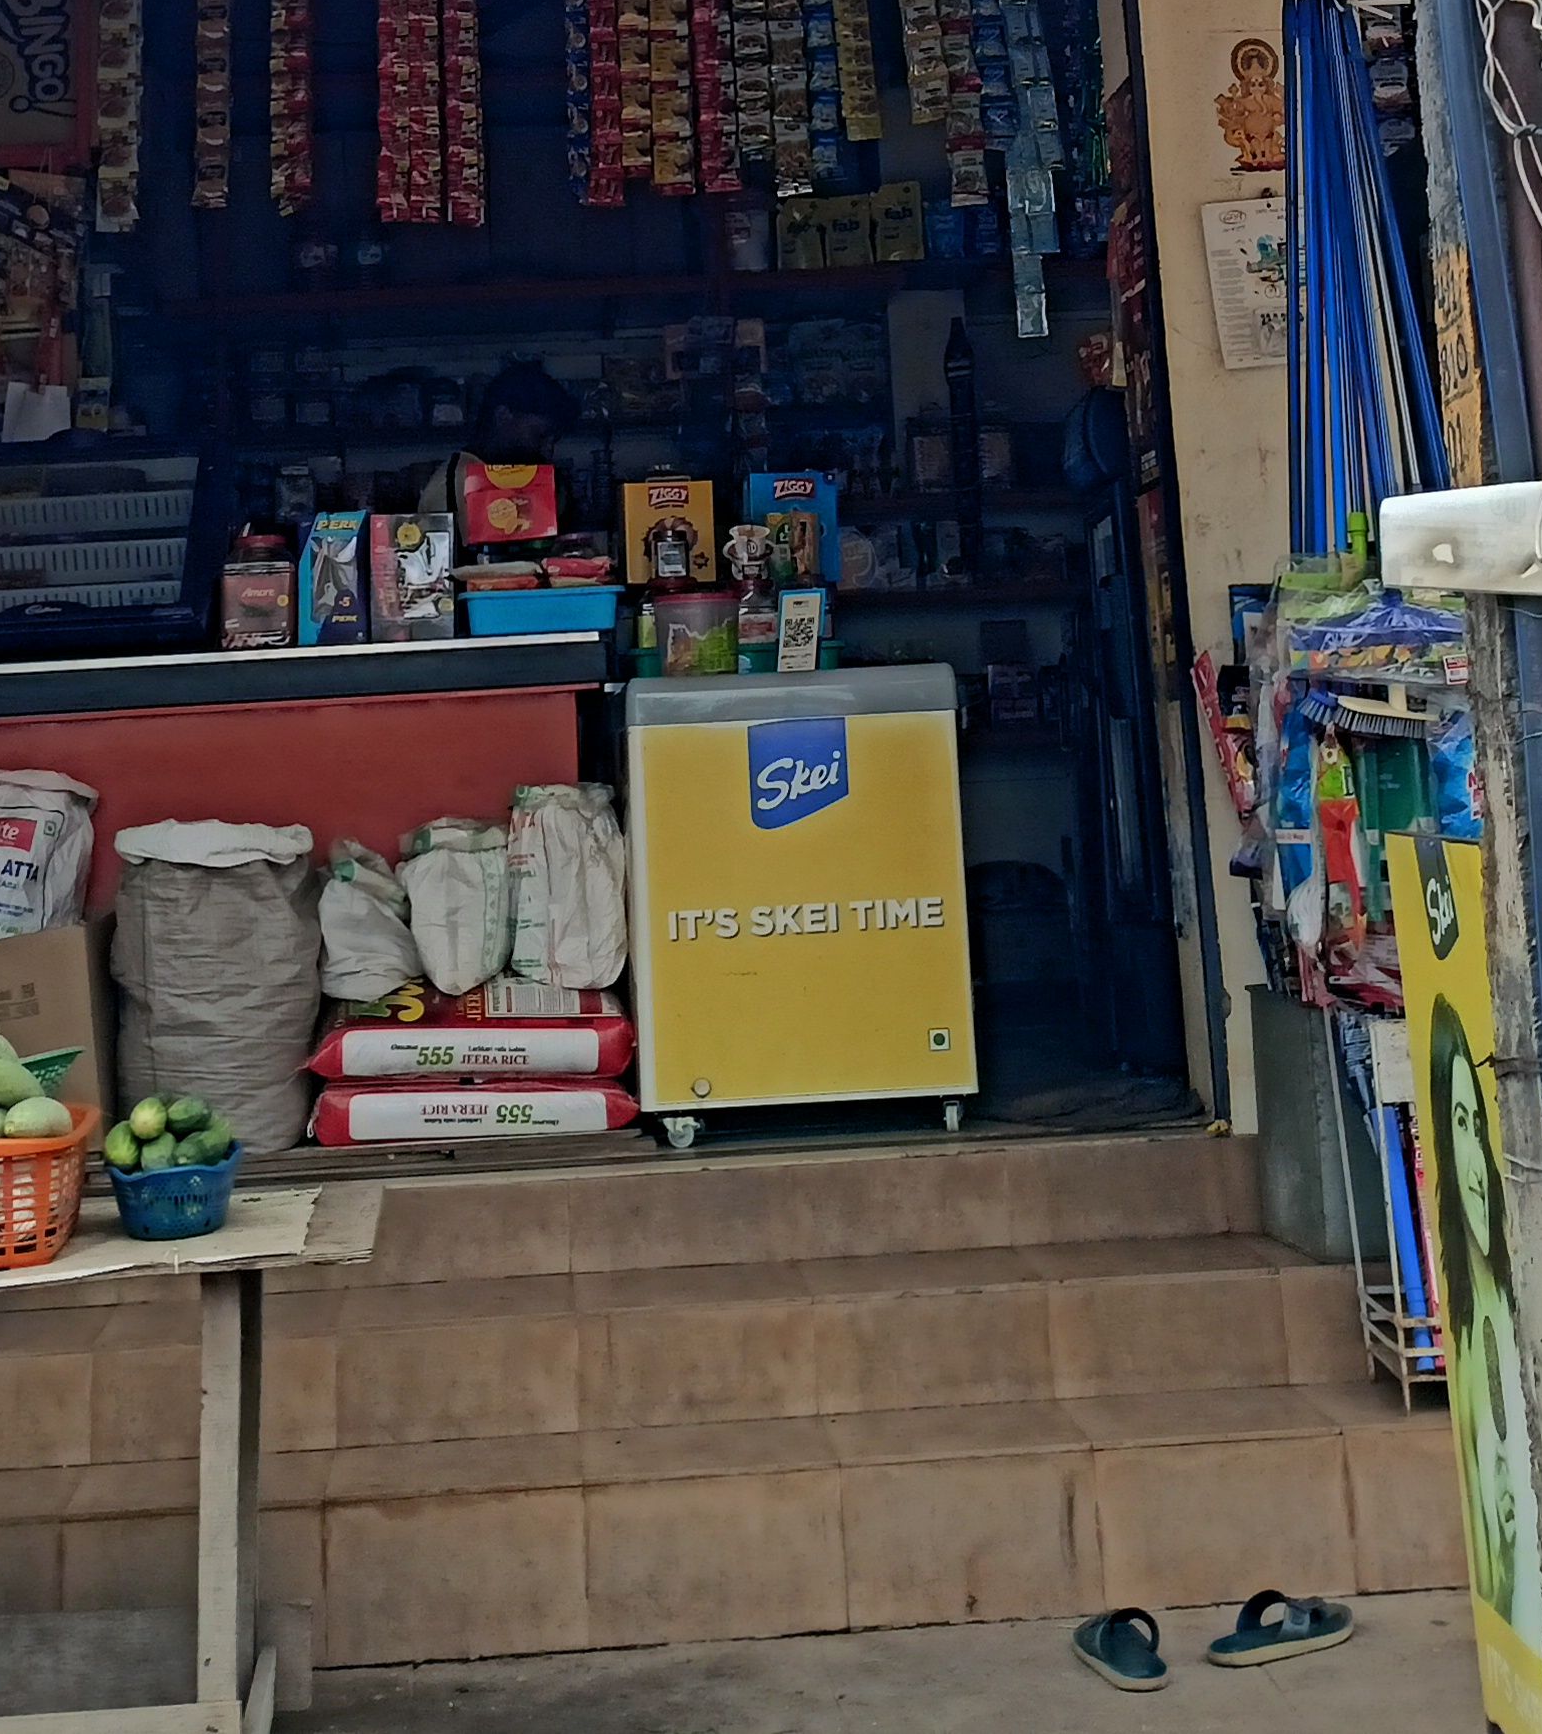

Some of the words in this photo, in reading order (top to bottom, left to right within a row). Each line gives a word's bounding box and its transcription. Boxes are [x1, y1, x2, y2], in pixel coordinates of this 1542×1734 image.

[757, 750, 841, 810] Skei
[1, 860, 40, 883] ATTA
[750, 902, 840, 937] SKEI
[849, 896, 945, 932] TIME
[416, 1045, 455, 1066] 555
[461, 1054, 499, 1066] JEERA
[501, 1054, 530, 1066] RICE
[420, 1104, 449, 1116] RICE
[453, 1104, 490, 1115] JEERA
[496, 1104, 534, 1124] 555
